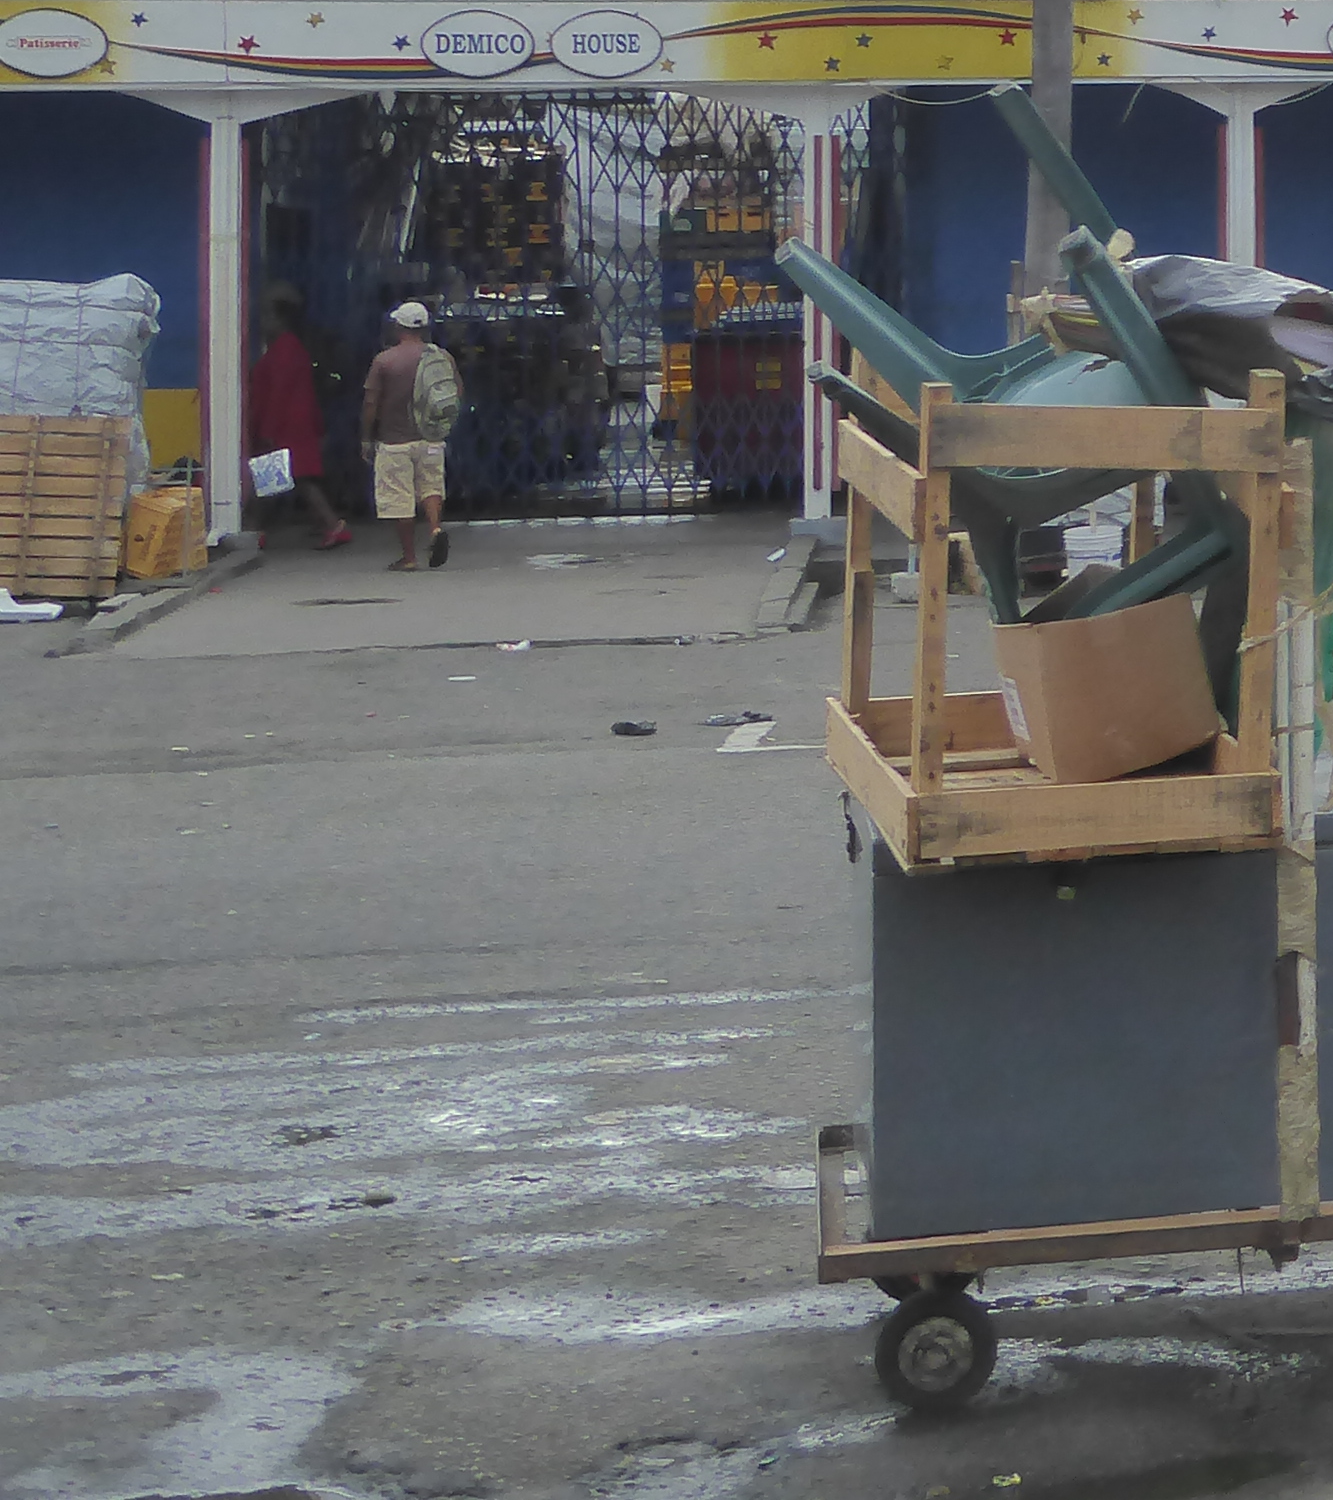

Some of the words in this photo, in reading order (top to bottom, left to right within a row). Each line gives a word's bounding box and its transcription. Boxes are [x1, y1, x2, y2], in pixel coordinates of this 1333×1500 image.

[19, 38, 80, 49] Patisserie
[435, 33, 526, 55] DEMICO
[572, 33, 641, 54] HOUSE
